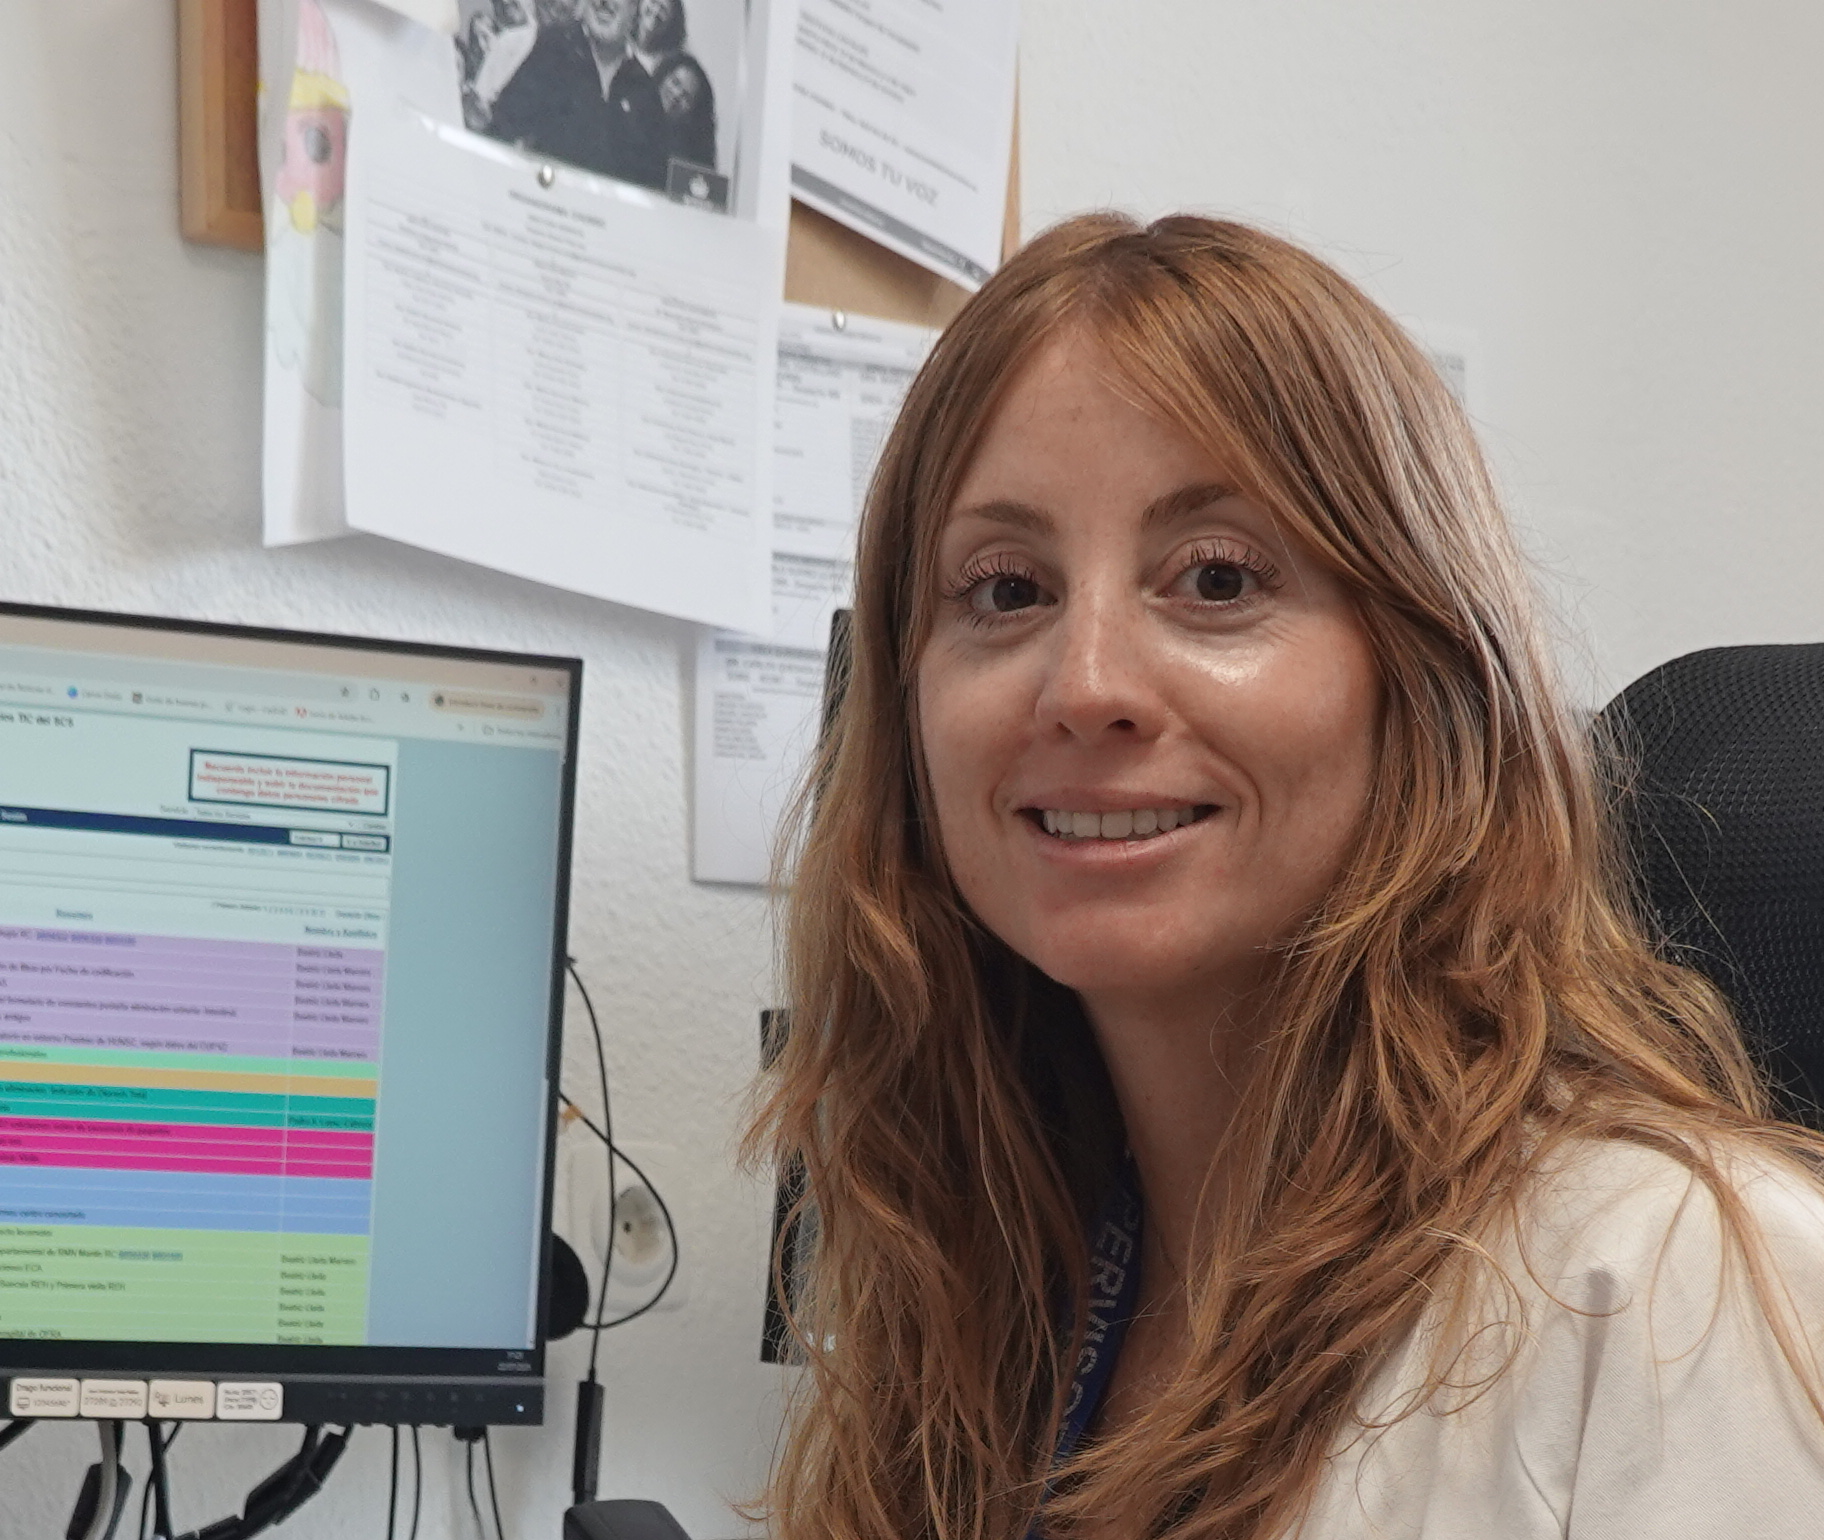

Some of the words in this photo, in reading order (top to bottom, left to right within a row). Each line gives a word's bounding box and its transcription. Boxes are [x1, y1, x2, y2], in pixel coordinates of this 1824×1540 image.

[819, 129, 876, 173] SOMOS
[882, 162, 902, 188] TU
[906, 176, 938, 206] VOZ
